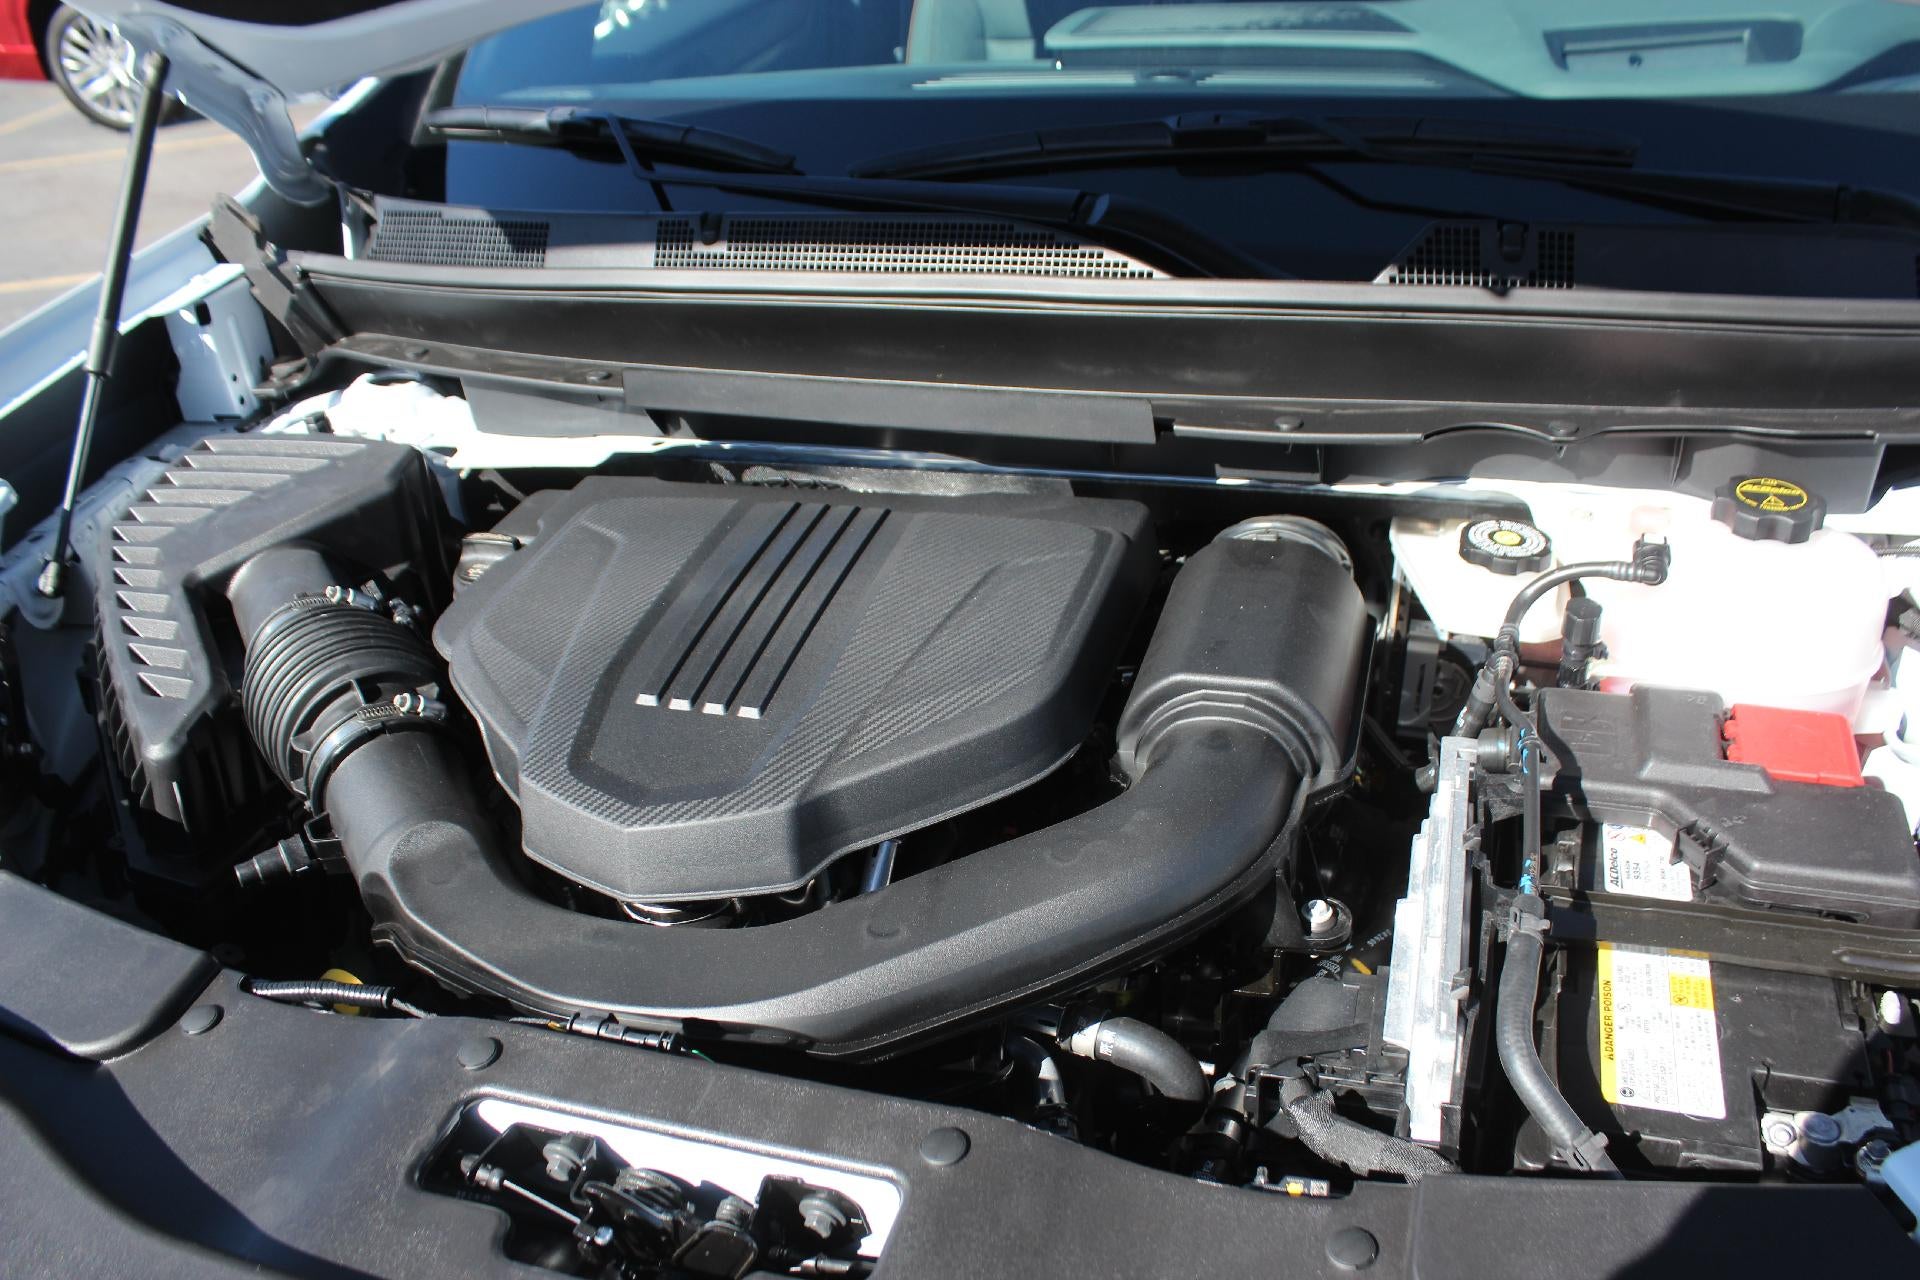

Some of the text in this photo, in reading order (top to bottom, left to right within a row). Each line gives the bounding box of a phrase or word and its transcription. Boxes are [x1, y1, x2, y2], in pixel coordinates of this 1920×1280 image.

[1609, 847, 1619, 887] ACDelco
[1603, 980, 1614, 1053] DANGER POISON
